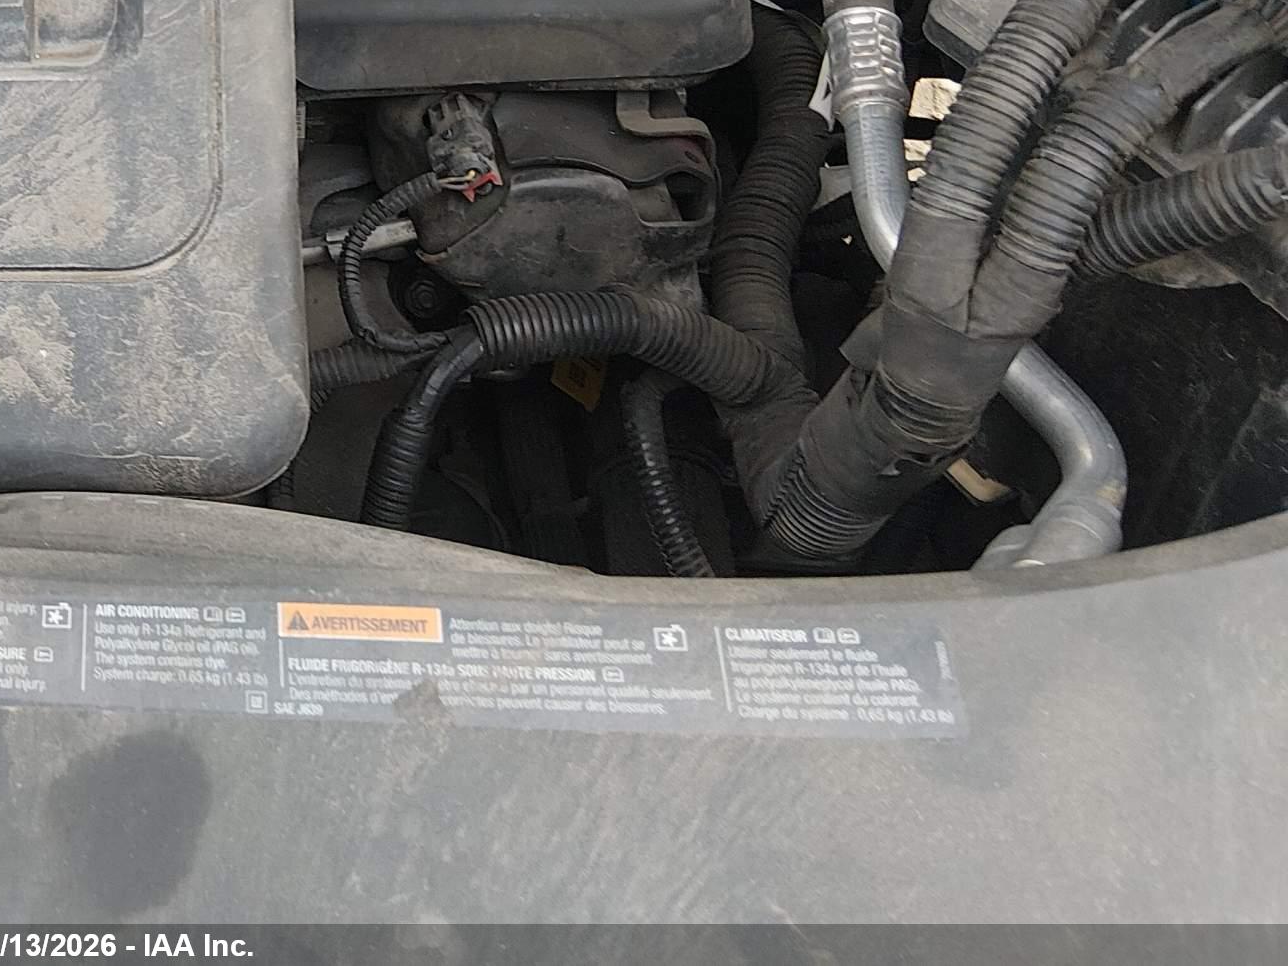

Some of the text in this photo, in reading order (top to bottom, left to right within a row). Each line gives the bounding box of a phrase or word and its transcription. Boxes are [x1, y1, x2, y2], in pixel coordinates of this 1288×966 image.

[95, 604, 200, 620] AIR CONDITIONING
[95, 622, 115, 635] Use
[117, 623, 139, 637] only
[142, 624, 182, 637] R-134a
[311, 616, 428, 634] AVERTISSEMENT
[725, 627, 808, 643] CLIMATISEUR
[95, 652, 115, 665] The
[117, 654, 155, 668] system
[157, 656, 203, 668] contains
[94, 666, 133, 682] System
[288, 658, 330, 672] FLUIDE
[412, 663, 455, 677] R-134a
[535, 667, 596, 682] PRESSION
[274, 702, 295, 714] SAE
